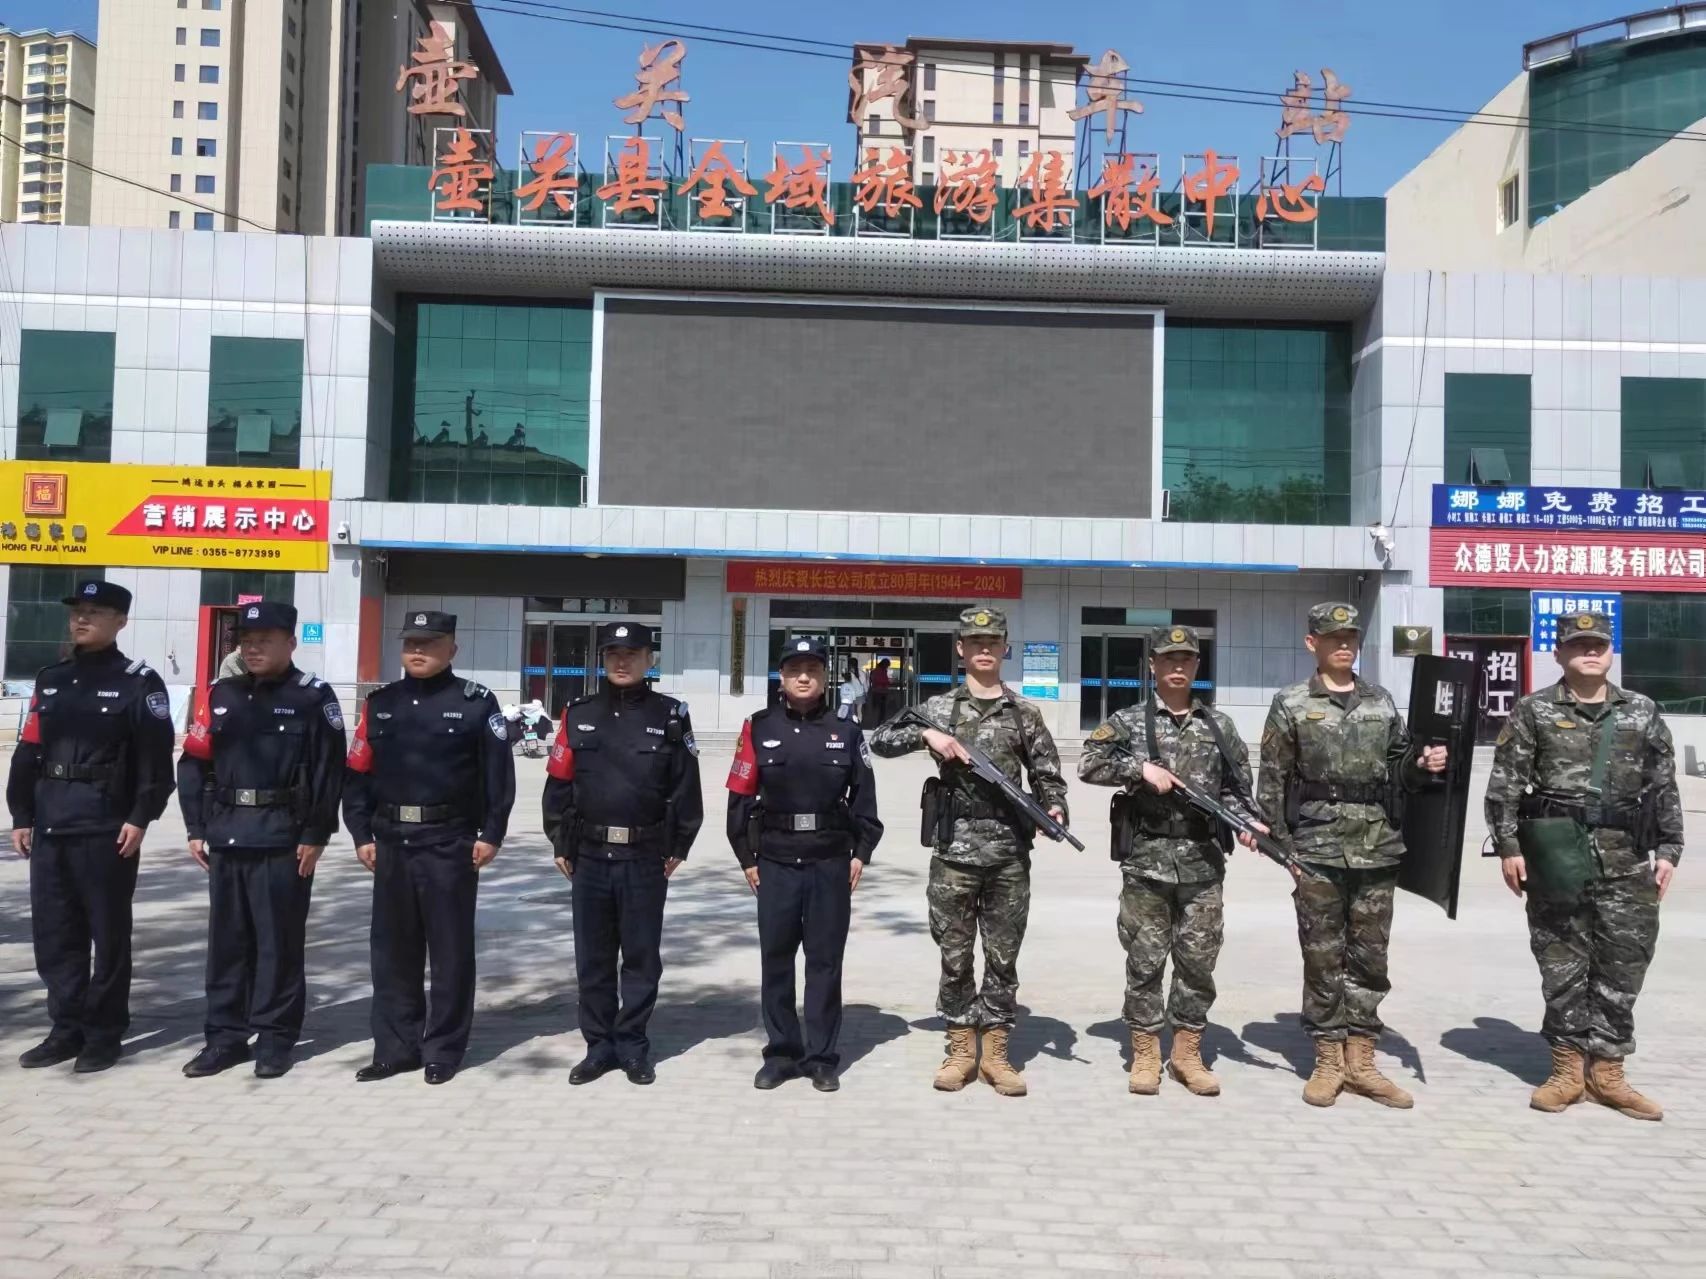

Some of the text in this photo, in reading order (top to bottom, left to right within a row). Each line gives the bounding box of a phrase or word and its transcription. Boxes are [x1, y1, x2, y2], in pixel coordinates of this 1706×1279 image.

[395, 20, 1352, 145] 壶关汽车站
[428, 127, 1324, 240] 壶关县全域旅游集散中心
[143, 504, 314, 531] 营销展示中心
[1450, 489, 1706, 516] 娜娜免费招工
[1, 543, 27, 551] HONG
[30, 544, 42, 552] FU
[62, 545, 87, 553] YUAN
[153, 546, 169, 554] VIP
[202, 548, 281, 558] 0355-8773999
[1454, 542, 1705, 578] 众德贤人力资源服务有限公司
[1487, 650, 1517, 716] 招工
